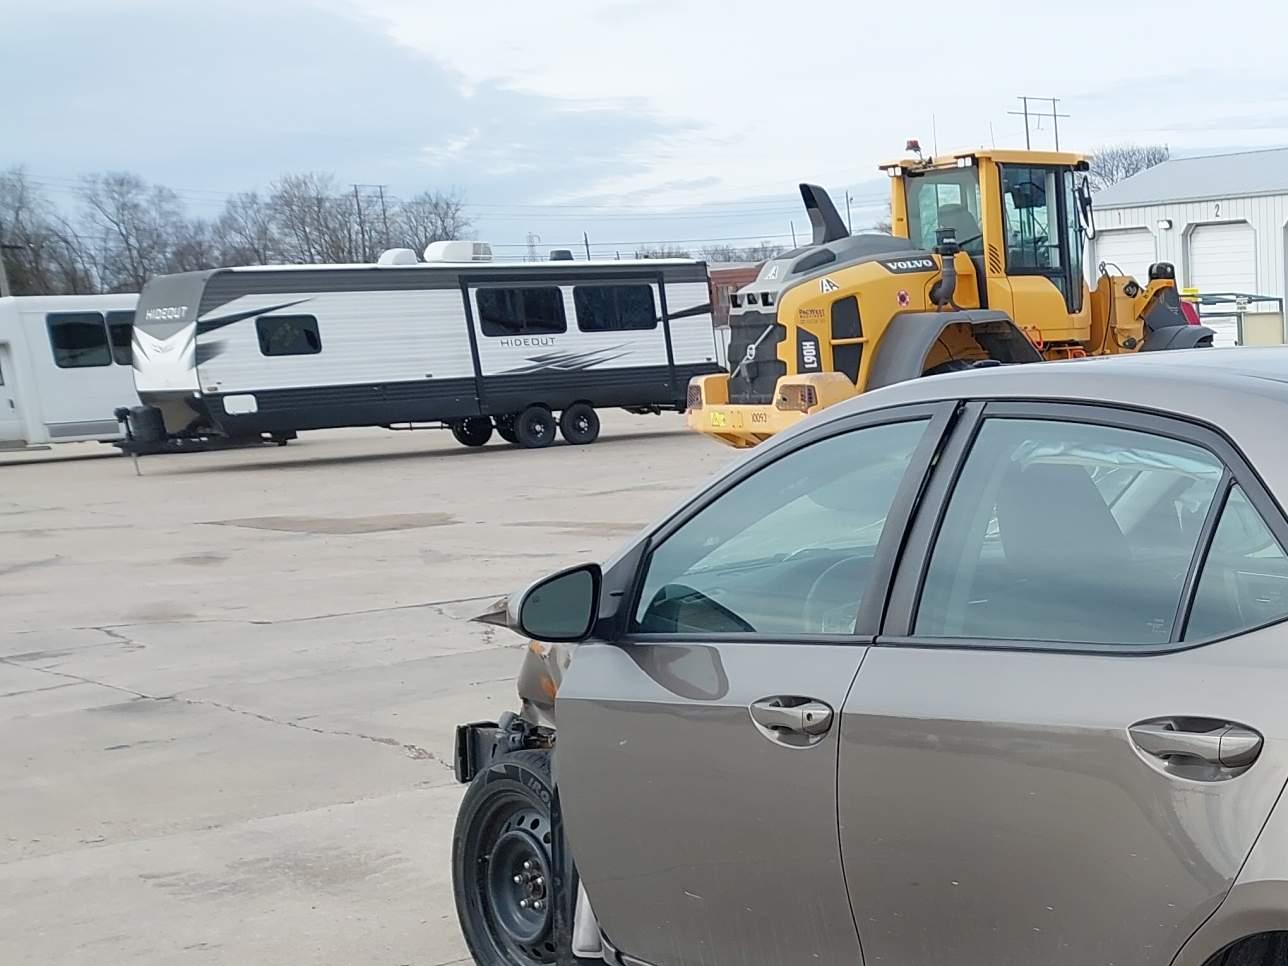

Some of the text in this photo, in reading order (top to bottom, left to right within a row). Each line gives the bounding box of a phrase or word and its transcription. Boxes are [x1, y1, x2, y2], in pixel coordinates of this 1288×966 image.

[1215, 203, 1221, 218] 2
[886, 259, 933, 270] VOLVO
[145, 305, 188, 320] HIDEOUT
[500, 337, 556, 347] HIDEOUT
[801, 341, 818, 368] L90H
